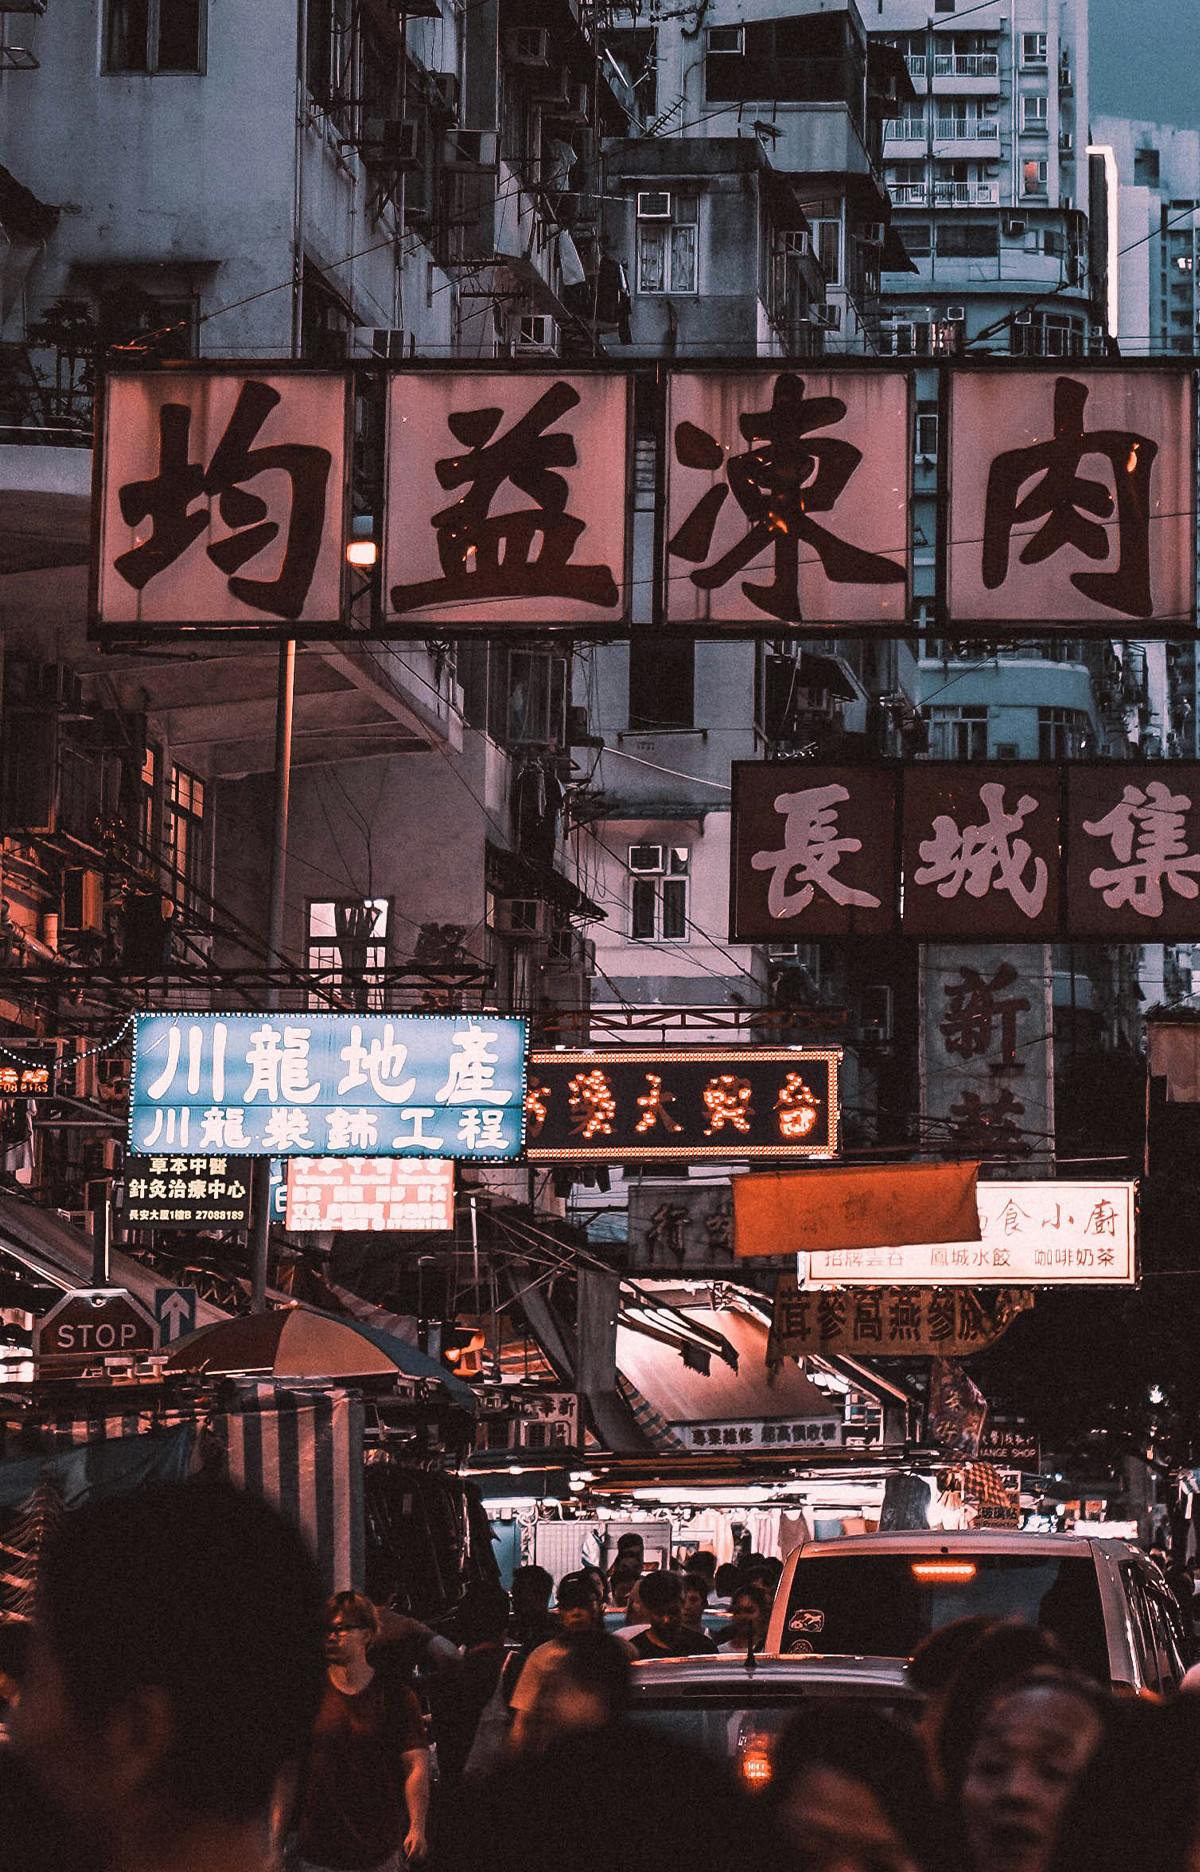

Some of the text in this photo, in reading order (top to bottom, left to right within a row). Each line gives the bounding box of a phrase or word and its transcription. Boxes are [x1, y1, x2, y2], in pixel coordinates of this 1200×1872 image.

[147, 1020, 514, 1106] 川龍地產
[143, 1107, 511, 1151] 川龍裝飾工程
[149, 1157, 228, 1176] 草本中醫
[128, 1178, 247, 1200] 針灸治療中心
[1034, 1247, 1116, 1267] 咖啡奶茶
[57, 1324, 138, 1349] STOP
[1011, 1448, 1037, 1459] SHOP
